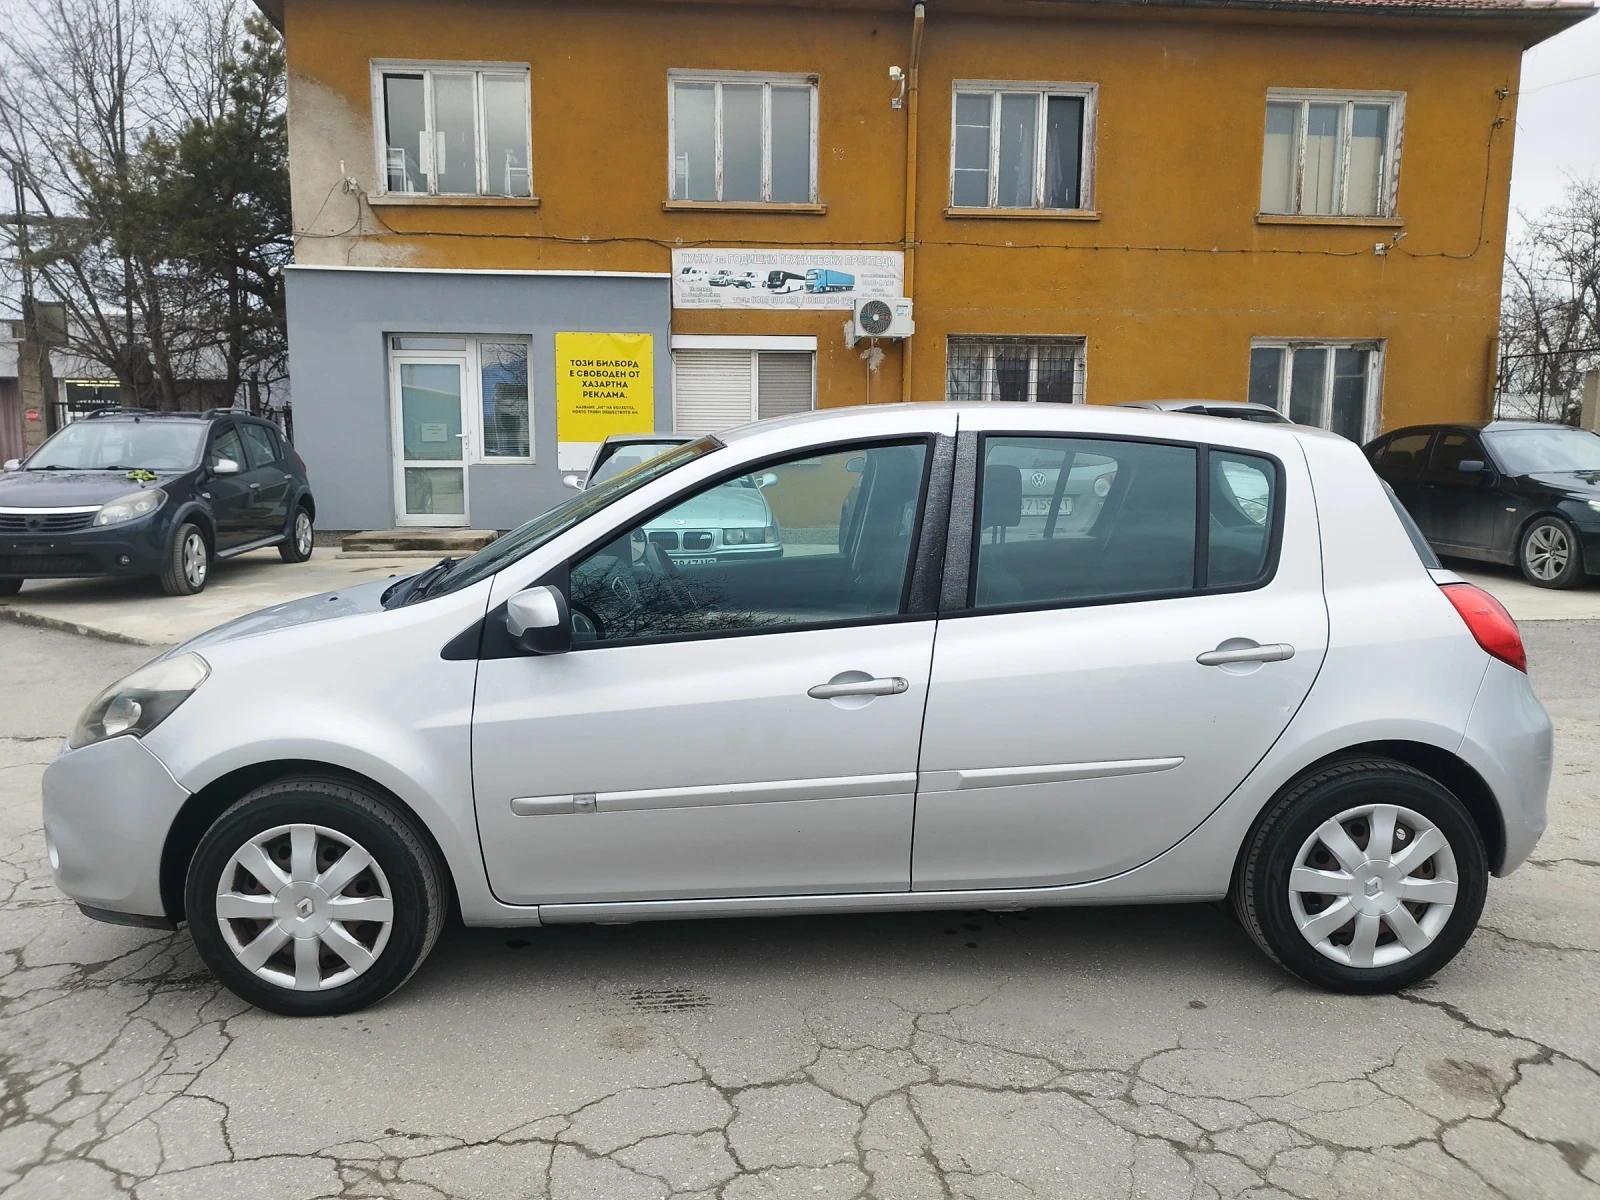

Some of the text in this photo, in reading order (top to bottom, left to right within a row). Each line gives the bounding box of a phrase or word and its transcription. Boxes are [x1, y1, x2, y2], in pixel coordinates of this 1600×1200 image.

[681, 253, 896, 268] ПУНКТ за ГОДИШНИ ТЕХНИЧЕСКИ ПРЕГЛЕДИ
[596, 360, 639, 368] БИЛБОРД
[576, 370, 626, 378] СВОБОДЕН
